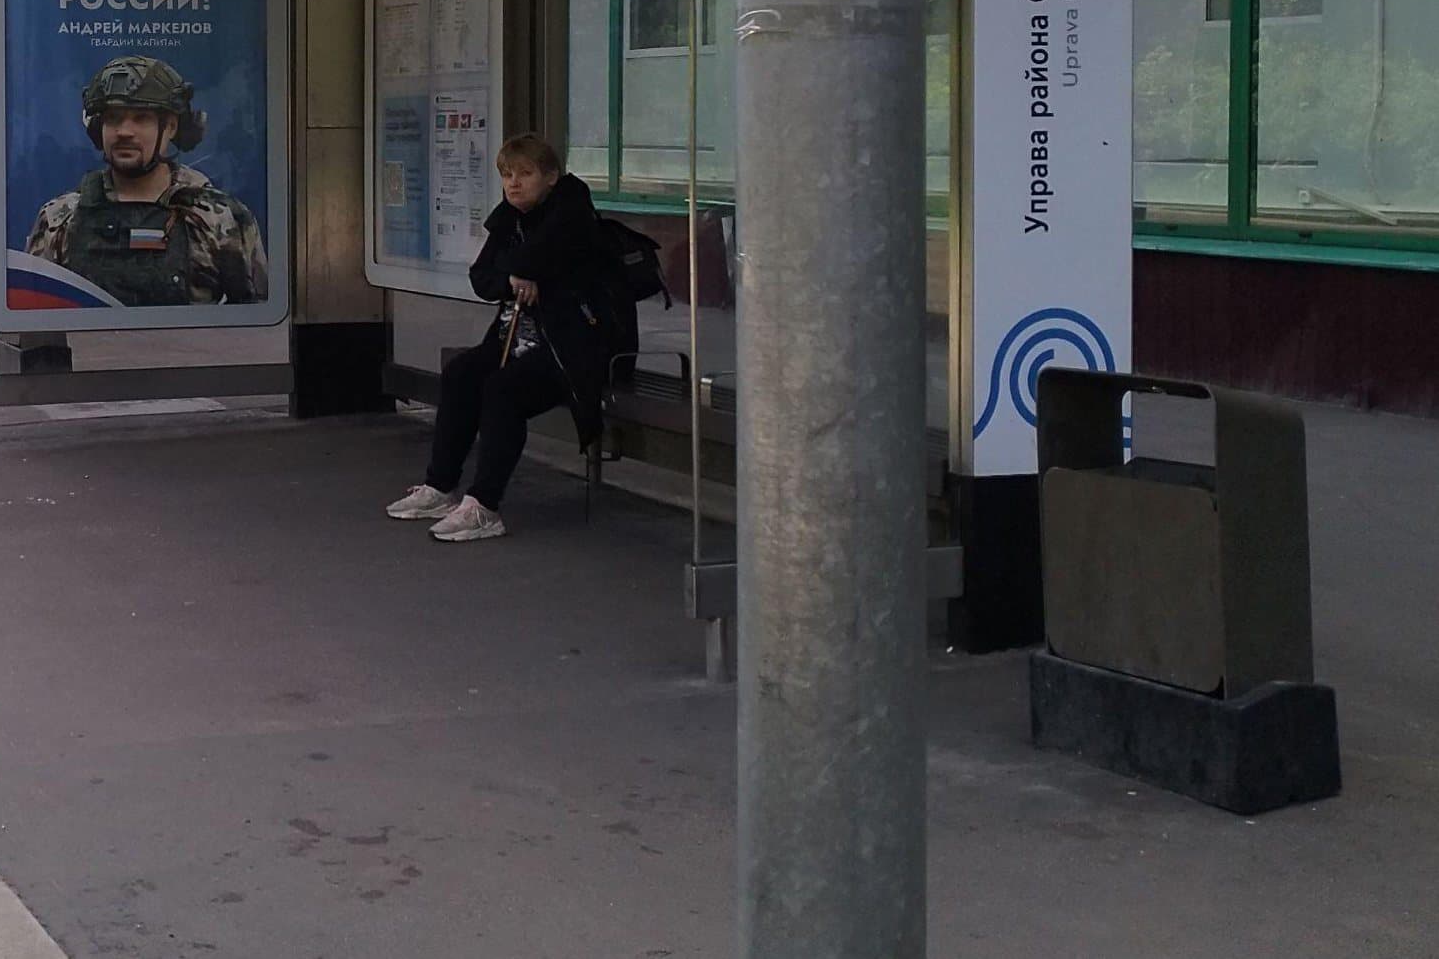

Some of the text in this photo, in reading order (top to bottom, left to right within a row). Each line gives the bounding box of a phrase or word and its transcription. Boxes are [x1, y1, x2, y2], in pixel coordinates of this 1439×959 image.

[58, 19, 213, 35] АНДРЕЙ МАРКЕЛОВ
[1025, 14, 1054, 118] района
[1062, 8, 1082, 87] Uprava
[1025, 130, 1054, 234] Управа
